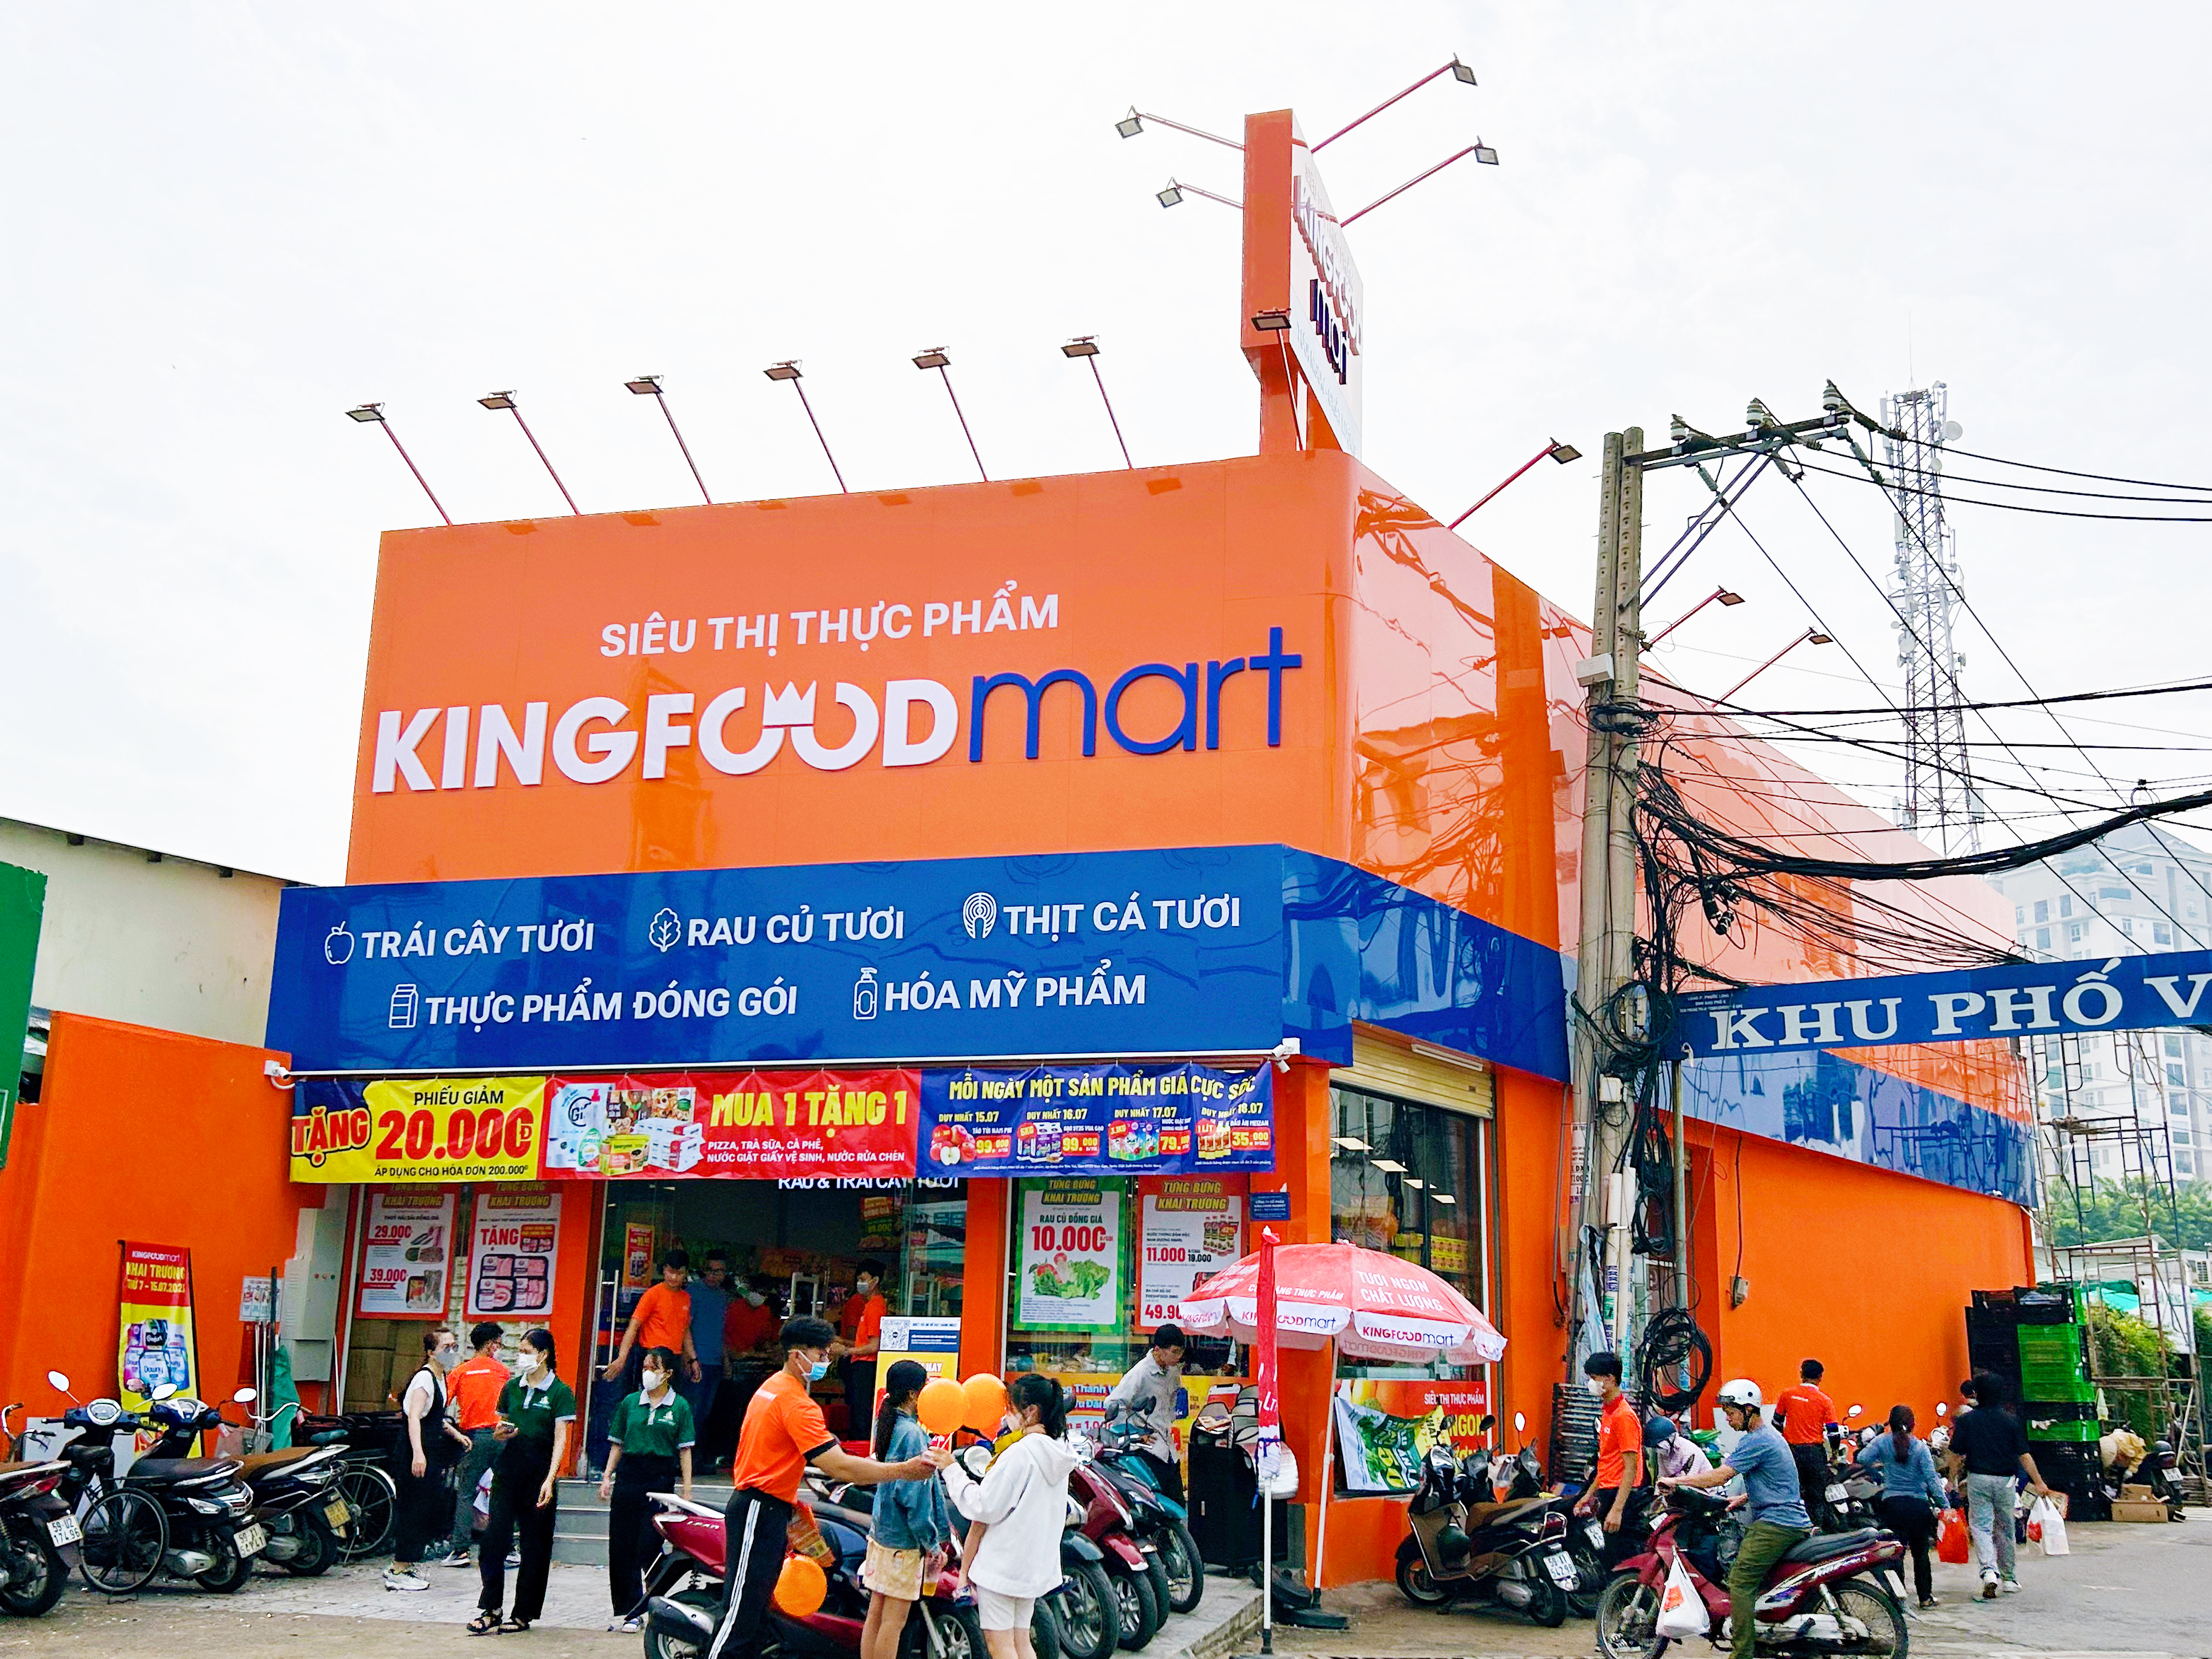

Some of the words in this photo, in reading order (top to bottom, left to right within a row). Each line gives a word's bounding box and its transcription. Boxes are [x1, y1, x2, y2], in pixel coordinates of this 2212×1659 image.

[600, 611, 696, 657] SIÊU
[707, 613, 779, 657] THỊ
[789, 600, 912, 652] THỰC
[923, 580, 1058, 637] PHẨM
[688, 916, 756, 946] RAU
[767, 904, 815, 943] CỦ
[822, 906, 904, 941] TƯƠI
[1003, 904, 1084, 942] THỊT
[1093, 891, 1146, 931] CÁ
[1152, 893, 1240, 929] TƯƠI
[362, 921, 436, 958] TRÁI
[444, 920, 510, 956] CÂY
[516, 919, 594, 952] TƯƠI
[885, 970, 961, 1011] HÓA
[969, 970, 1028, 1008] MỸ
[1035, 958, 1146, 1007] PHẨM
[425, 991, 514, 1033] THỰC
[522, 977, 622, 1022] PHẨM
[633, 980, 730, 1019] ĐÓNG
[738, 976, 797, 1016] GÓI
[1711, 998, 1901, 1050] KHU
[1929, 958, 2123, 1035] PHỐ
[414, 1086, 459, 1105] PHIẾU
[463, 1085, 504, 1104] GIẢM
[949, 1073, 978, 1099] MỖI
[981, 1077, 1025, 1099] NGÀY
[1030, 1074, 1064, 1103] MỘT
[1068, 1073, 1103, 1096] SẢN
[1108, 1069, 1156, 1096] PHẨM
[1160, 1071, 1188, 1095] GIÁ
[1190, 1075, 1224, 1101] CỰC
[710, 1092, 774, 1126] MUA
[783, 1092, 797, 1126] 1
[805, 1084, 887, 1138] TẶNG
[894, 1091, 907, 1124] 1
[939, 1114, 953, 1122] DUY
[954, 1110, 974, 1122] NHẤT
[975, 1111, 999, 1122] 15.07
[1026, 1111, 1041, 1120] DUY
[1042, 1108, 1062, 1120] NHẤT
[1063, 1108, 1088, 1120] 16.07
[1114, 1109, 1128, 1118] DUY
[1130, 1107, 1150, 1118] NHẤT
[1152, 1107, 1177, 1118] 17.07
[1201, 1107, 1216, 1118] DUY
[1237, 1103, 1263, 1114] 18.07
[292, 1108, 370, 1164] TẶNG
[708, 1141, 739, 1151] PIZZA,
[762, 1138, 785, 1151] SỮA,
[802, 1138, 824, 1151] PHÊ,
[707, 1151, 735, 1162] NƯỚC
[737, 1152, 758, 1164] GIẶT
[760, 1150, 783, 1162] GIẤY
[785, 1150, 798, 1164] VỆ
[799, 1153, 825, 1163] SINH,
[827, 1150, 855, 1161] NƯỚC
[857, 1150, 877, 1161] RỬA
[878, 1150, 905, 1161] CHÉN
[374, 1165, 387, 1176] ÁP
[390, 1167, 416, 1180] DỤNG
[418, 1167, 439, 1177] CHO
[442, 1165, 463, 1177] HÓA
[465, 1165, 486, 1176] ĐƠN
[1043, 1192, 1065, 1203] KHAI
[1066, 1192, 1101, 1203] TRƯƠNG
[1158, 1197, 1183, 1211] KHAI
[1184, 1195, 1229, 1211] TRƯƠNG
[1040, 1214, 1054, 1223] RAU
[1057, 1211, 1066, 1223] CỦ
[1090, 1212, 1103, 1223] GIÁ
[480, 1224, 519, 1251] TẶNG
[1146, 1247, 1186, 1262] 11.000
[1188, 1254, 1211, 1262] 19.000
[126, 1262, 147, 1277] KHAI
[150, 1265, 185, 1280] TRƯƠNG
[139, 1280, 144, 1290] 7
[1356, 1270, 1389, 1287] TƯƠI
[1390, 1276, 1430, 1293] NGON
[1360, 1286, 1395, 1305] CHẤT
[1398, 1293, 1444, 1312] LƯỢNG
